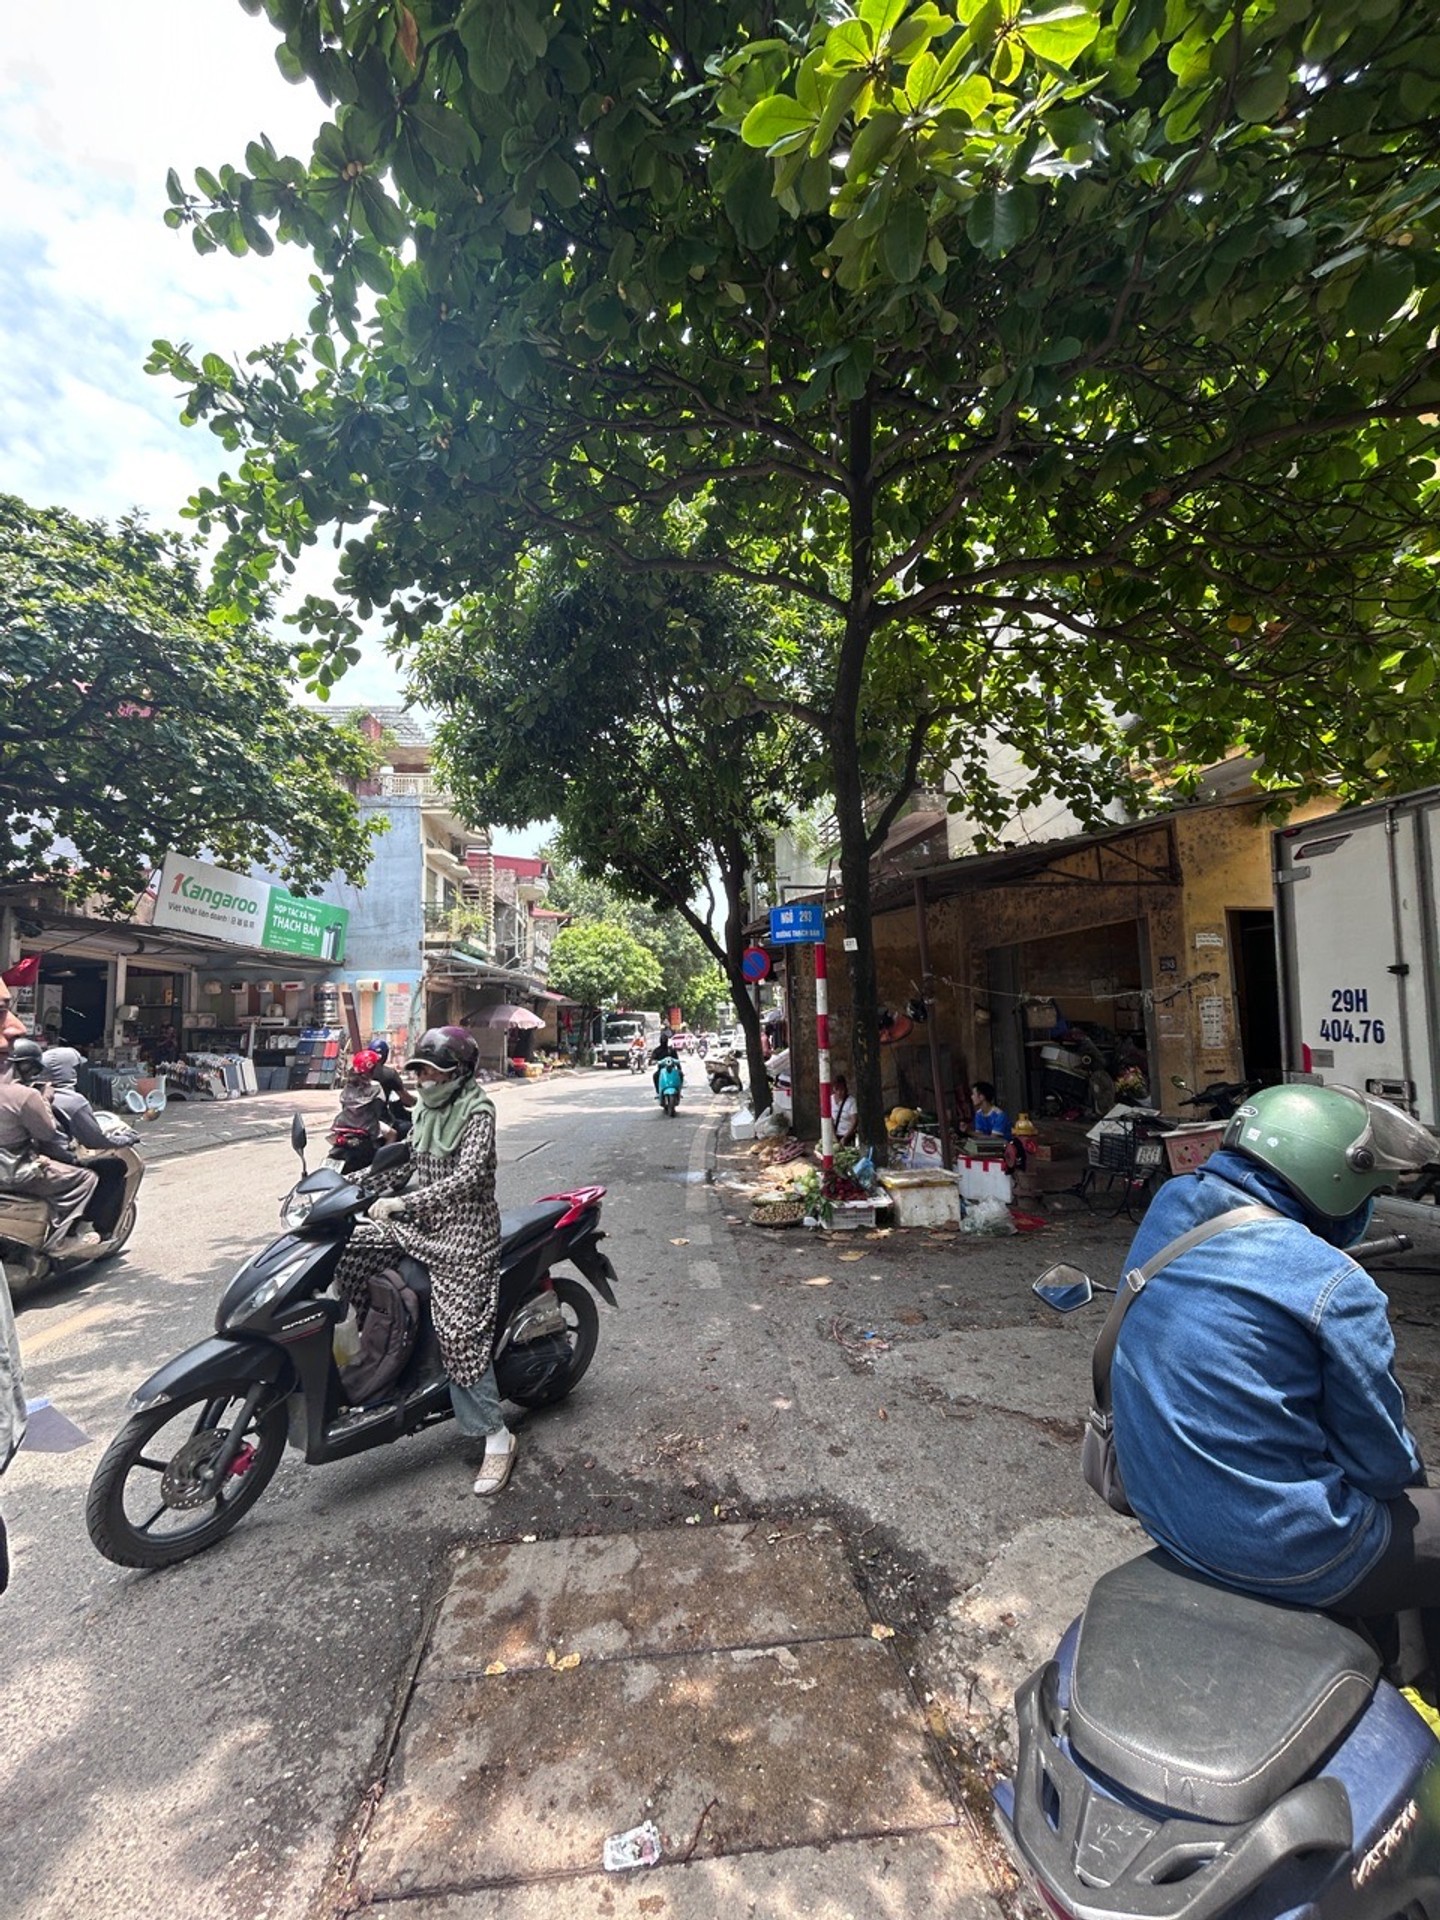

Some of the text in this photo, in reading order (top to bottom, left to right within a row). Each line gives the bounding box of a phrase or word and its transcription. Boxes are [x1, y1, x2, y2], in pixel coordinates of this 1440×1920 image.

[272, 915, 301, 933] THẠCH
[302, 922, 321, 937] BÀN
[1332, 988, 1367, 1012] 29H
[1320, 1019, 1385, 1044] 404.76
